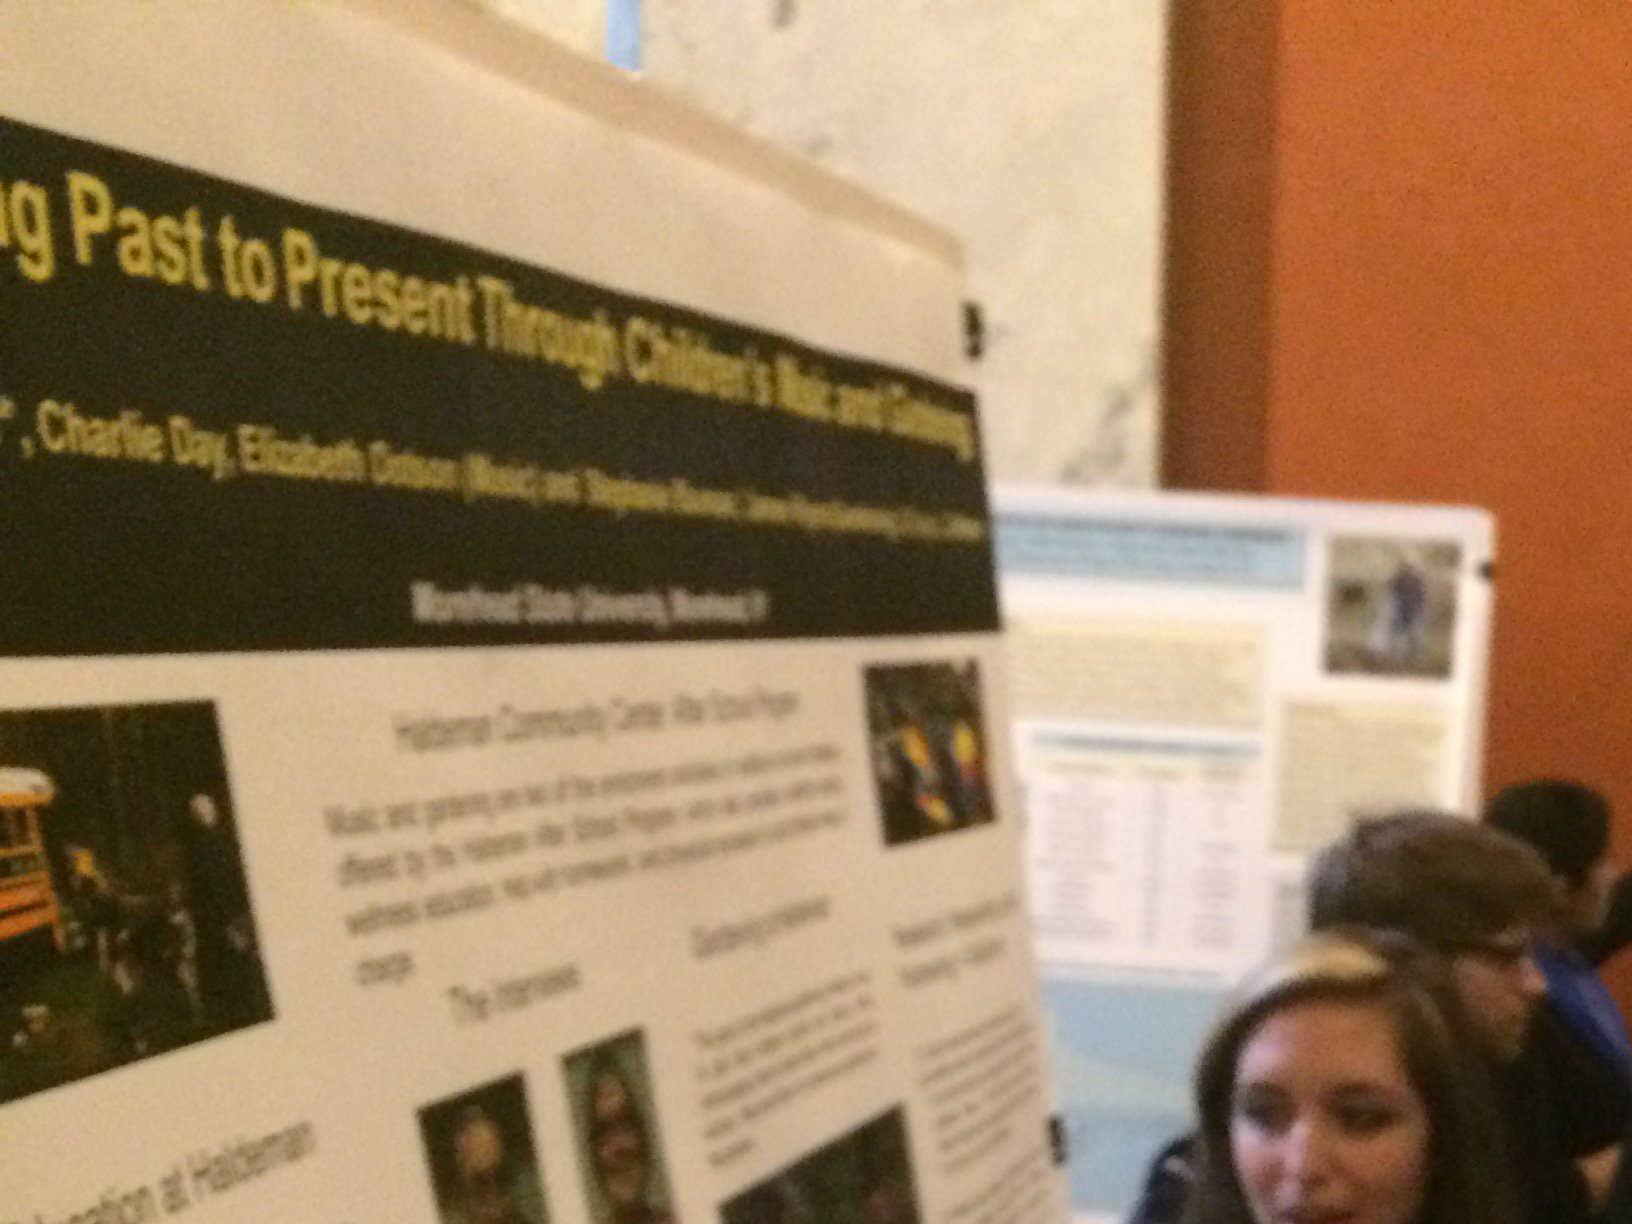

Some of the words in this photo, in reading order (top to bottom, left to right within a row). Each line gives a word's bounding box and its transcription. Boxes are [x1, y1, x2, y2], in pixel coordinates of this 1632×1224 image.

[68, 170, 208, 290] Past
[219, 216, 274, 302] to
[283, 228, 473, 343] Present
[477, 275, 617, 391] Through
[37, 400, 163, 463] Charlie
[168, 415, 236, 482] Day,
[159, 1168, 191, 1216] at
